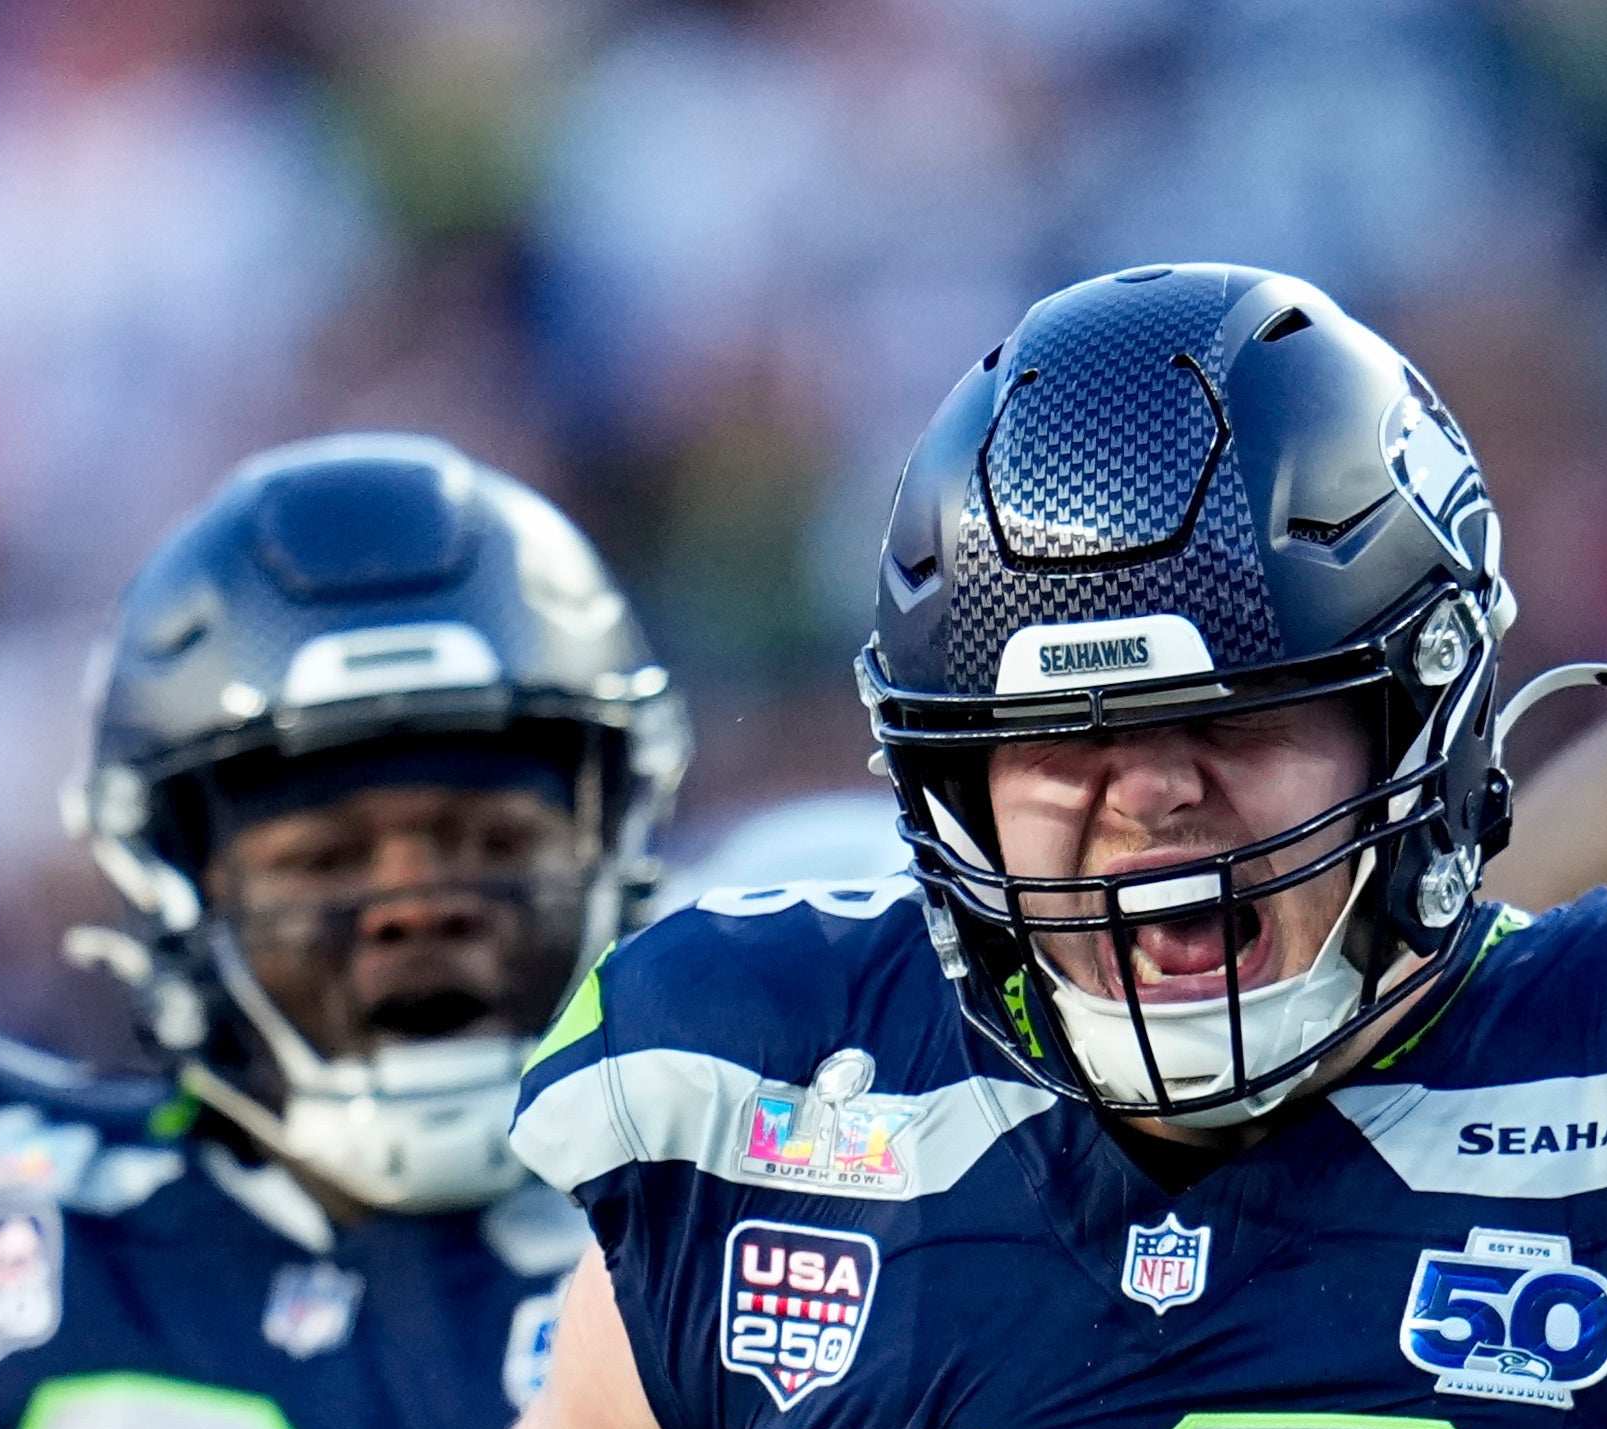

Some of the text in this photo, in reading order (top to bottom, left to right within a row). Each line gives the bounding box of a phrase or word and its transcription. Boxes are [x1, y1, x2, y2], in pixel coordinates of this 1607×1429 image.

[1039, 636, 1150, 675] SEAHAWKS
[764, 1162, 885, 1186] SUPER BOWL
[1488, 1242, 1551, 1258] EST 1976
[742, 1243, 861, 1298] USA
[1137, 1258, 1190, 1296] NFL
[730, 1314, 852, 1373] 250
